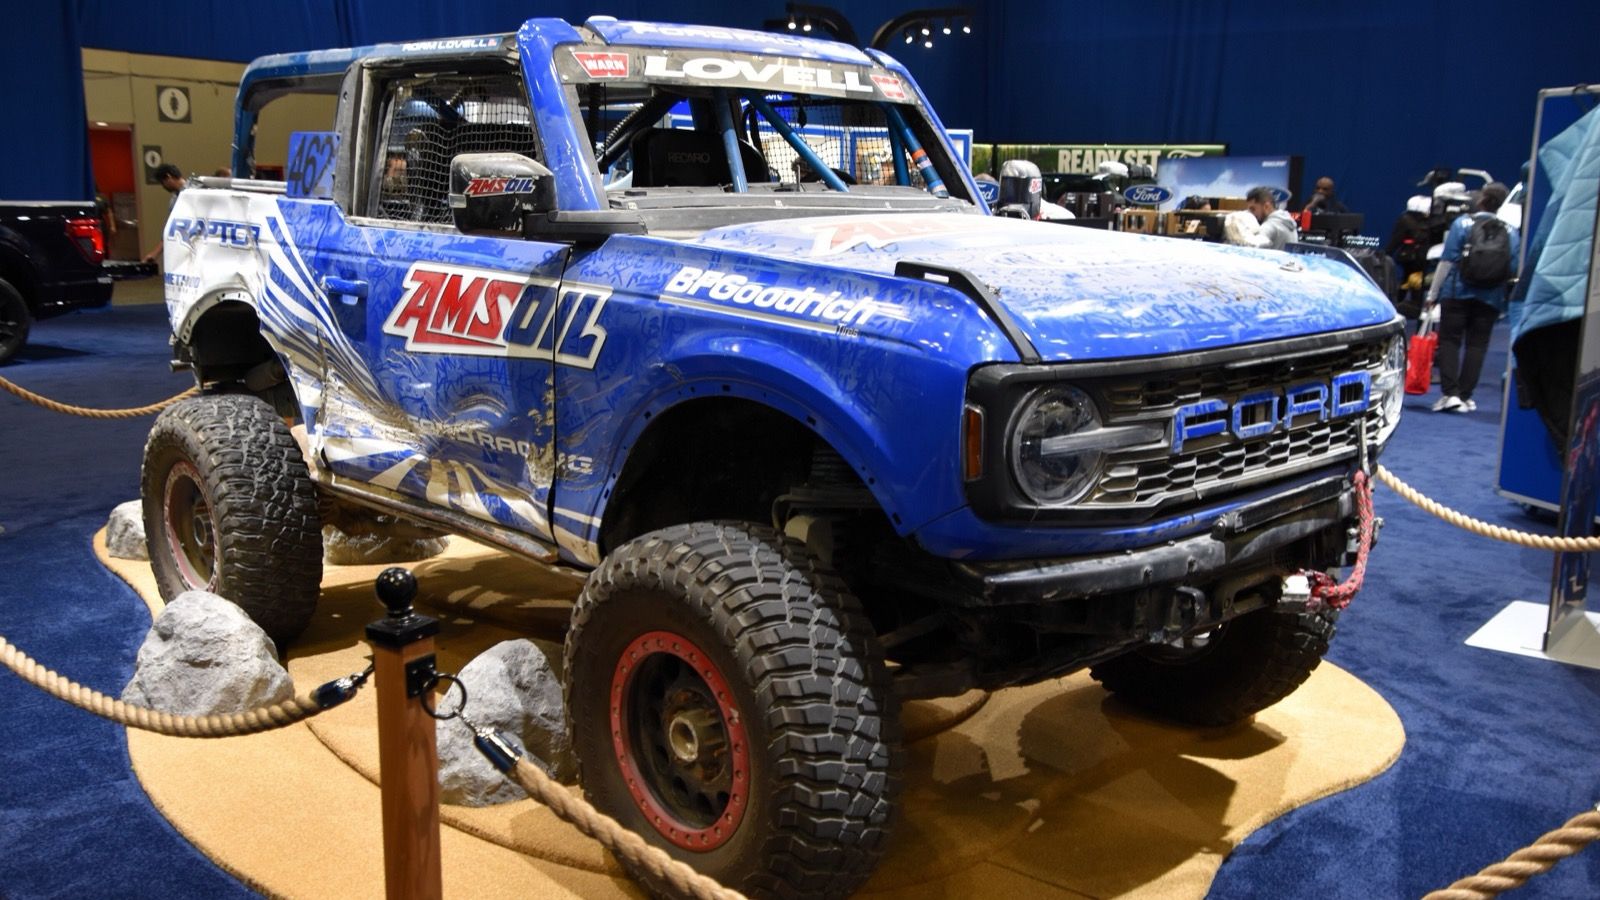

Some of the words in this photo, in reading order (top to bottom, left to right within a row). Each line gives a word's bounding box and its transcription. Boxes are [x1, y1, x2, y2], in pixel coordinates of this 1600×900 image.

[438, 38, 487, 50] LOVELL
[584, 57, 625, 71] WARN
[643, 55, 874, 93] LOVELL
[667, 152, 711, 164] RECARO
[1057, 149, 1122, 174] READY
[1124, 149, 1160, 176] SET
[464, 177, 536, 197] AMSOIL
[1132, 187, 1161, 202] Ford
[167, 217, 262, 250] RAPTOR
[664, 266, 875, 326] BFGoodrich
[389, 265, 609, 362] AMSOIL
[1171, 369, 1372, 454] FORD
[475, 431, 593, 475] RACG
